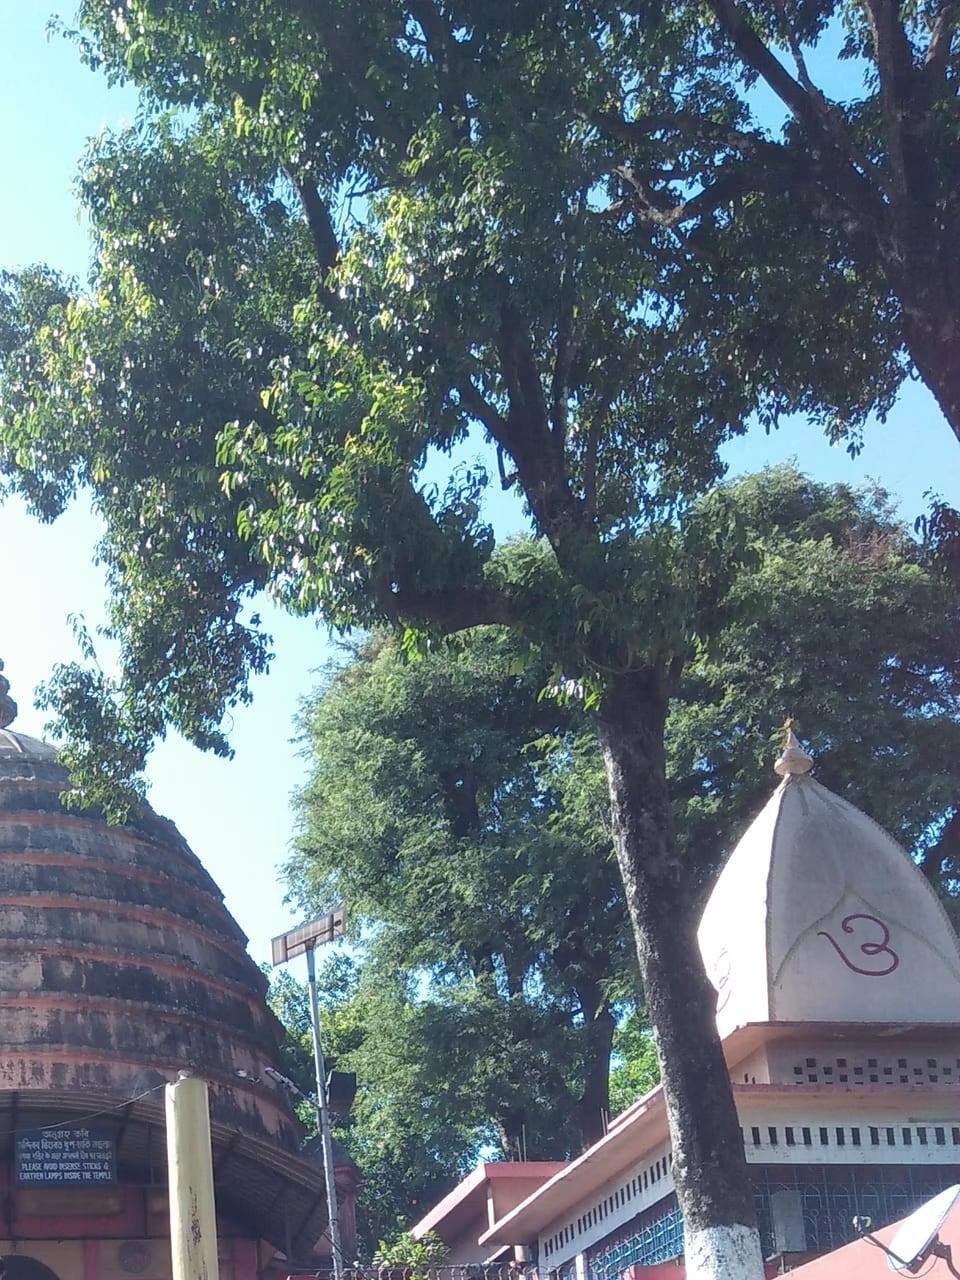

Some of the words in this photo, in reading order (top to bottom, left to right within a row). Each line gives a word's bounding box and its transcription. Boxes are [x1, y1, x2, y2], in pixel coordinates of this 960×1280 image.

[21, 1163, 42, 1171] PLEASE
[43, 1162, 58, 1171] AVOID
[82, 1162, 102, 1170] STICKS
[45, 1171, 63, 1180] LAMPS
[64, 1171, 82, 1180] INSIDE
[82, 1171, 92, 1180] THE
[93, 1171, 113, 1180] TEMPLE
